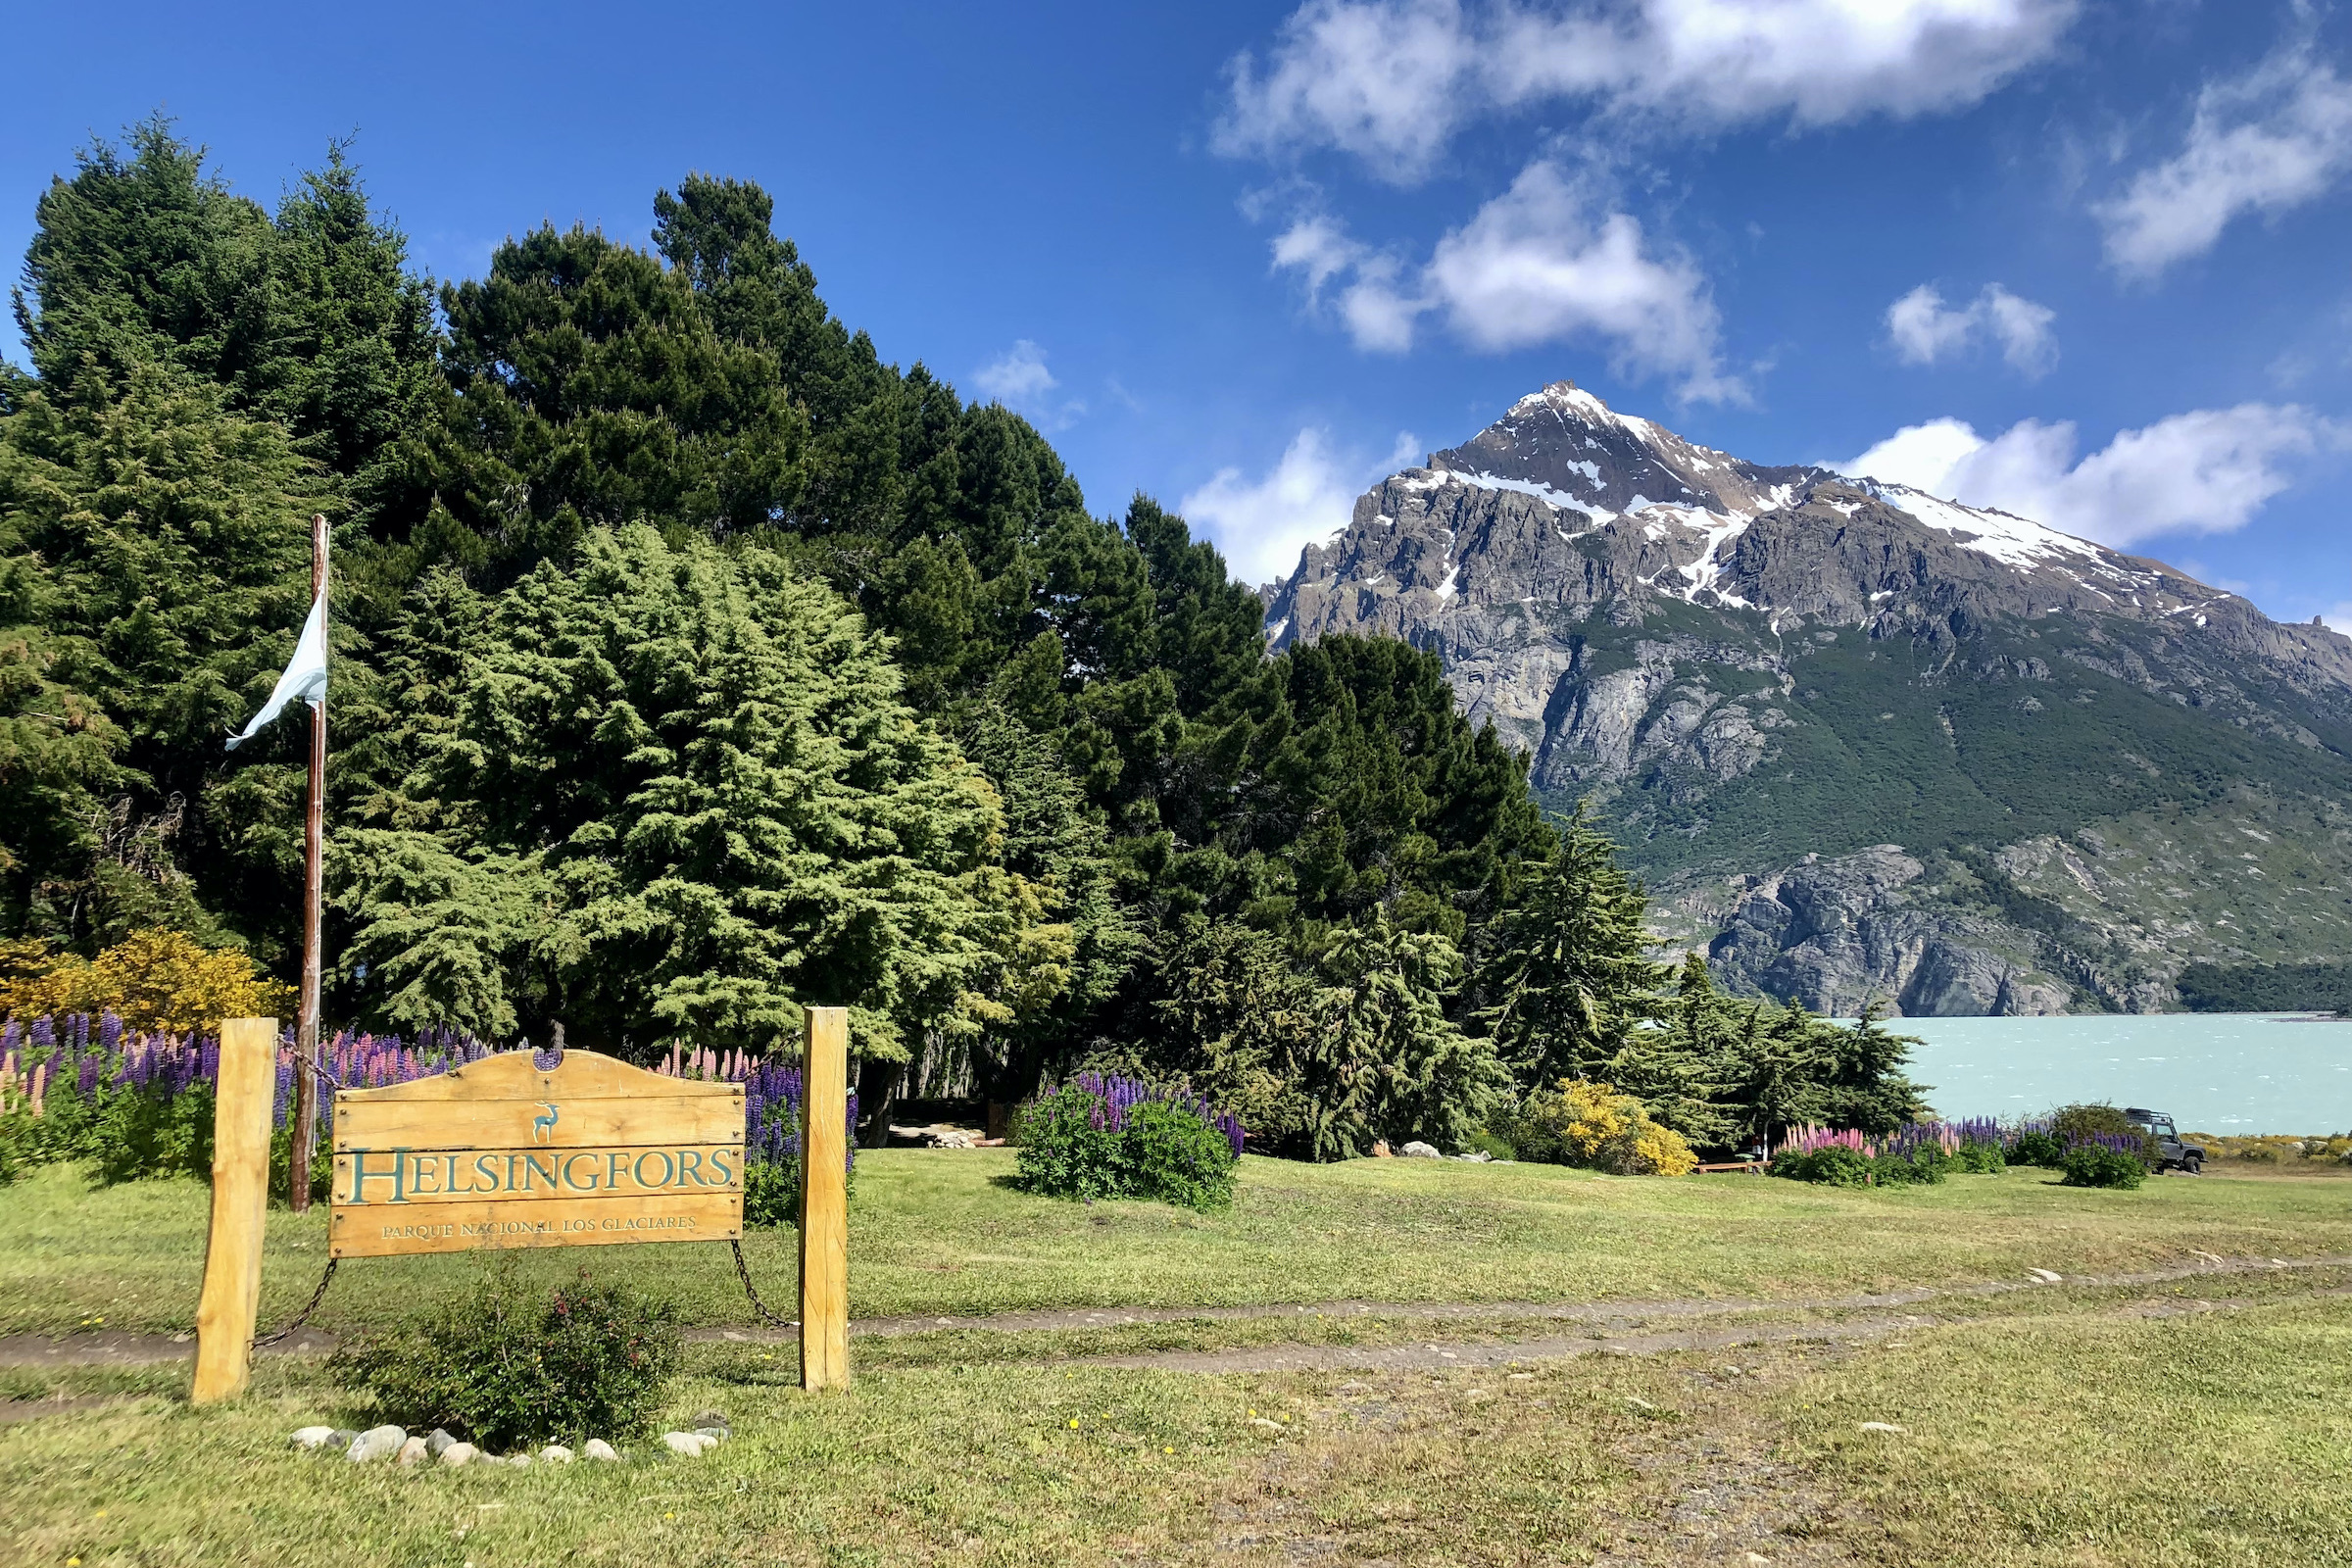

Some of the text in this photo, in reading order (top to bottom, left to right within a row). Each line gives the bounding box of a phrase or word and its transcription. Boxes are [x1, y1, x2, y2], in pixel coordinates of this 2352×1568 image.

[347, 1147, 733, 1204] HELSINGFORS
[381, 1215, 697, 1241] PARQUE NACIONAL LOS GLACIARES
